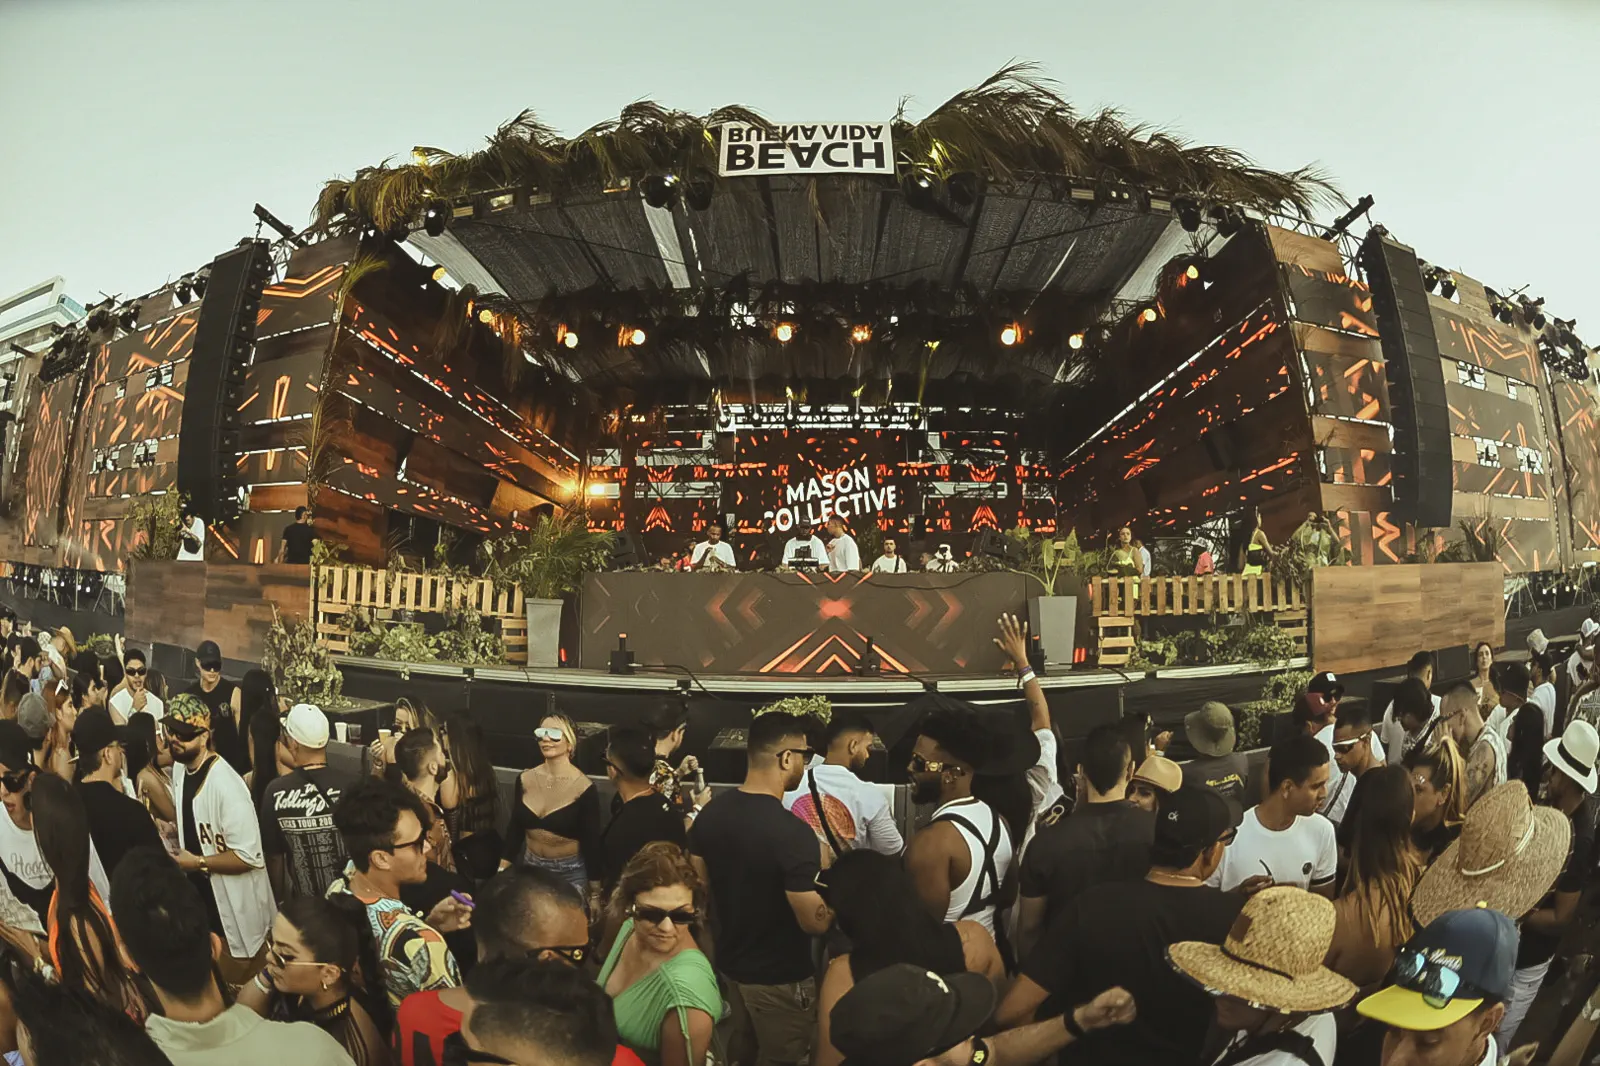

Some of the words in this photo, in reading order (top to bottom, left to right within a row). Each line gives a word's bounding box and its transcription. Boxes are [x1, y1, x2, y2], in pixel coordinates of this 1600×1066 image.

[726, 142, 885, 171] BEACH
[786, 466, 870, 505] MASON
[298, 819, 317, 828] TOUR
[318, 816, 333, 826] 200
